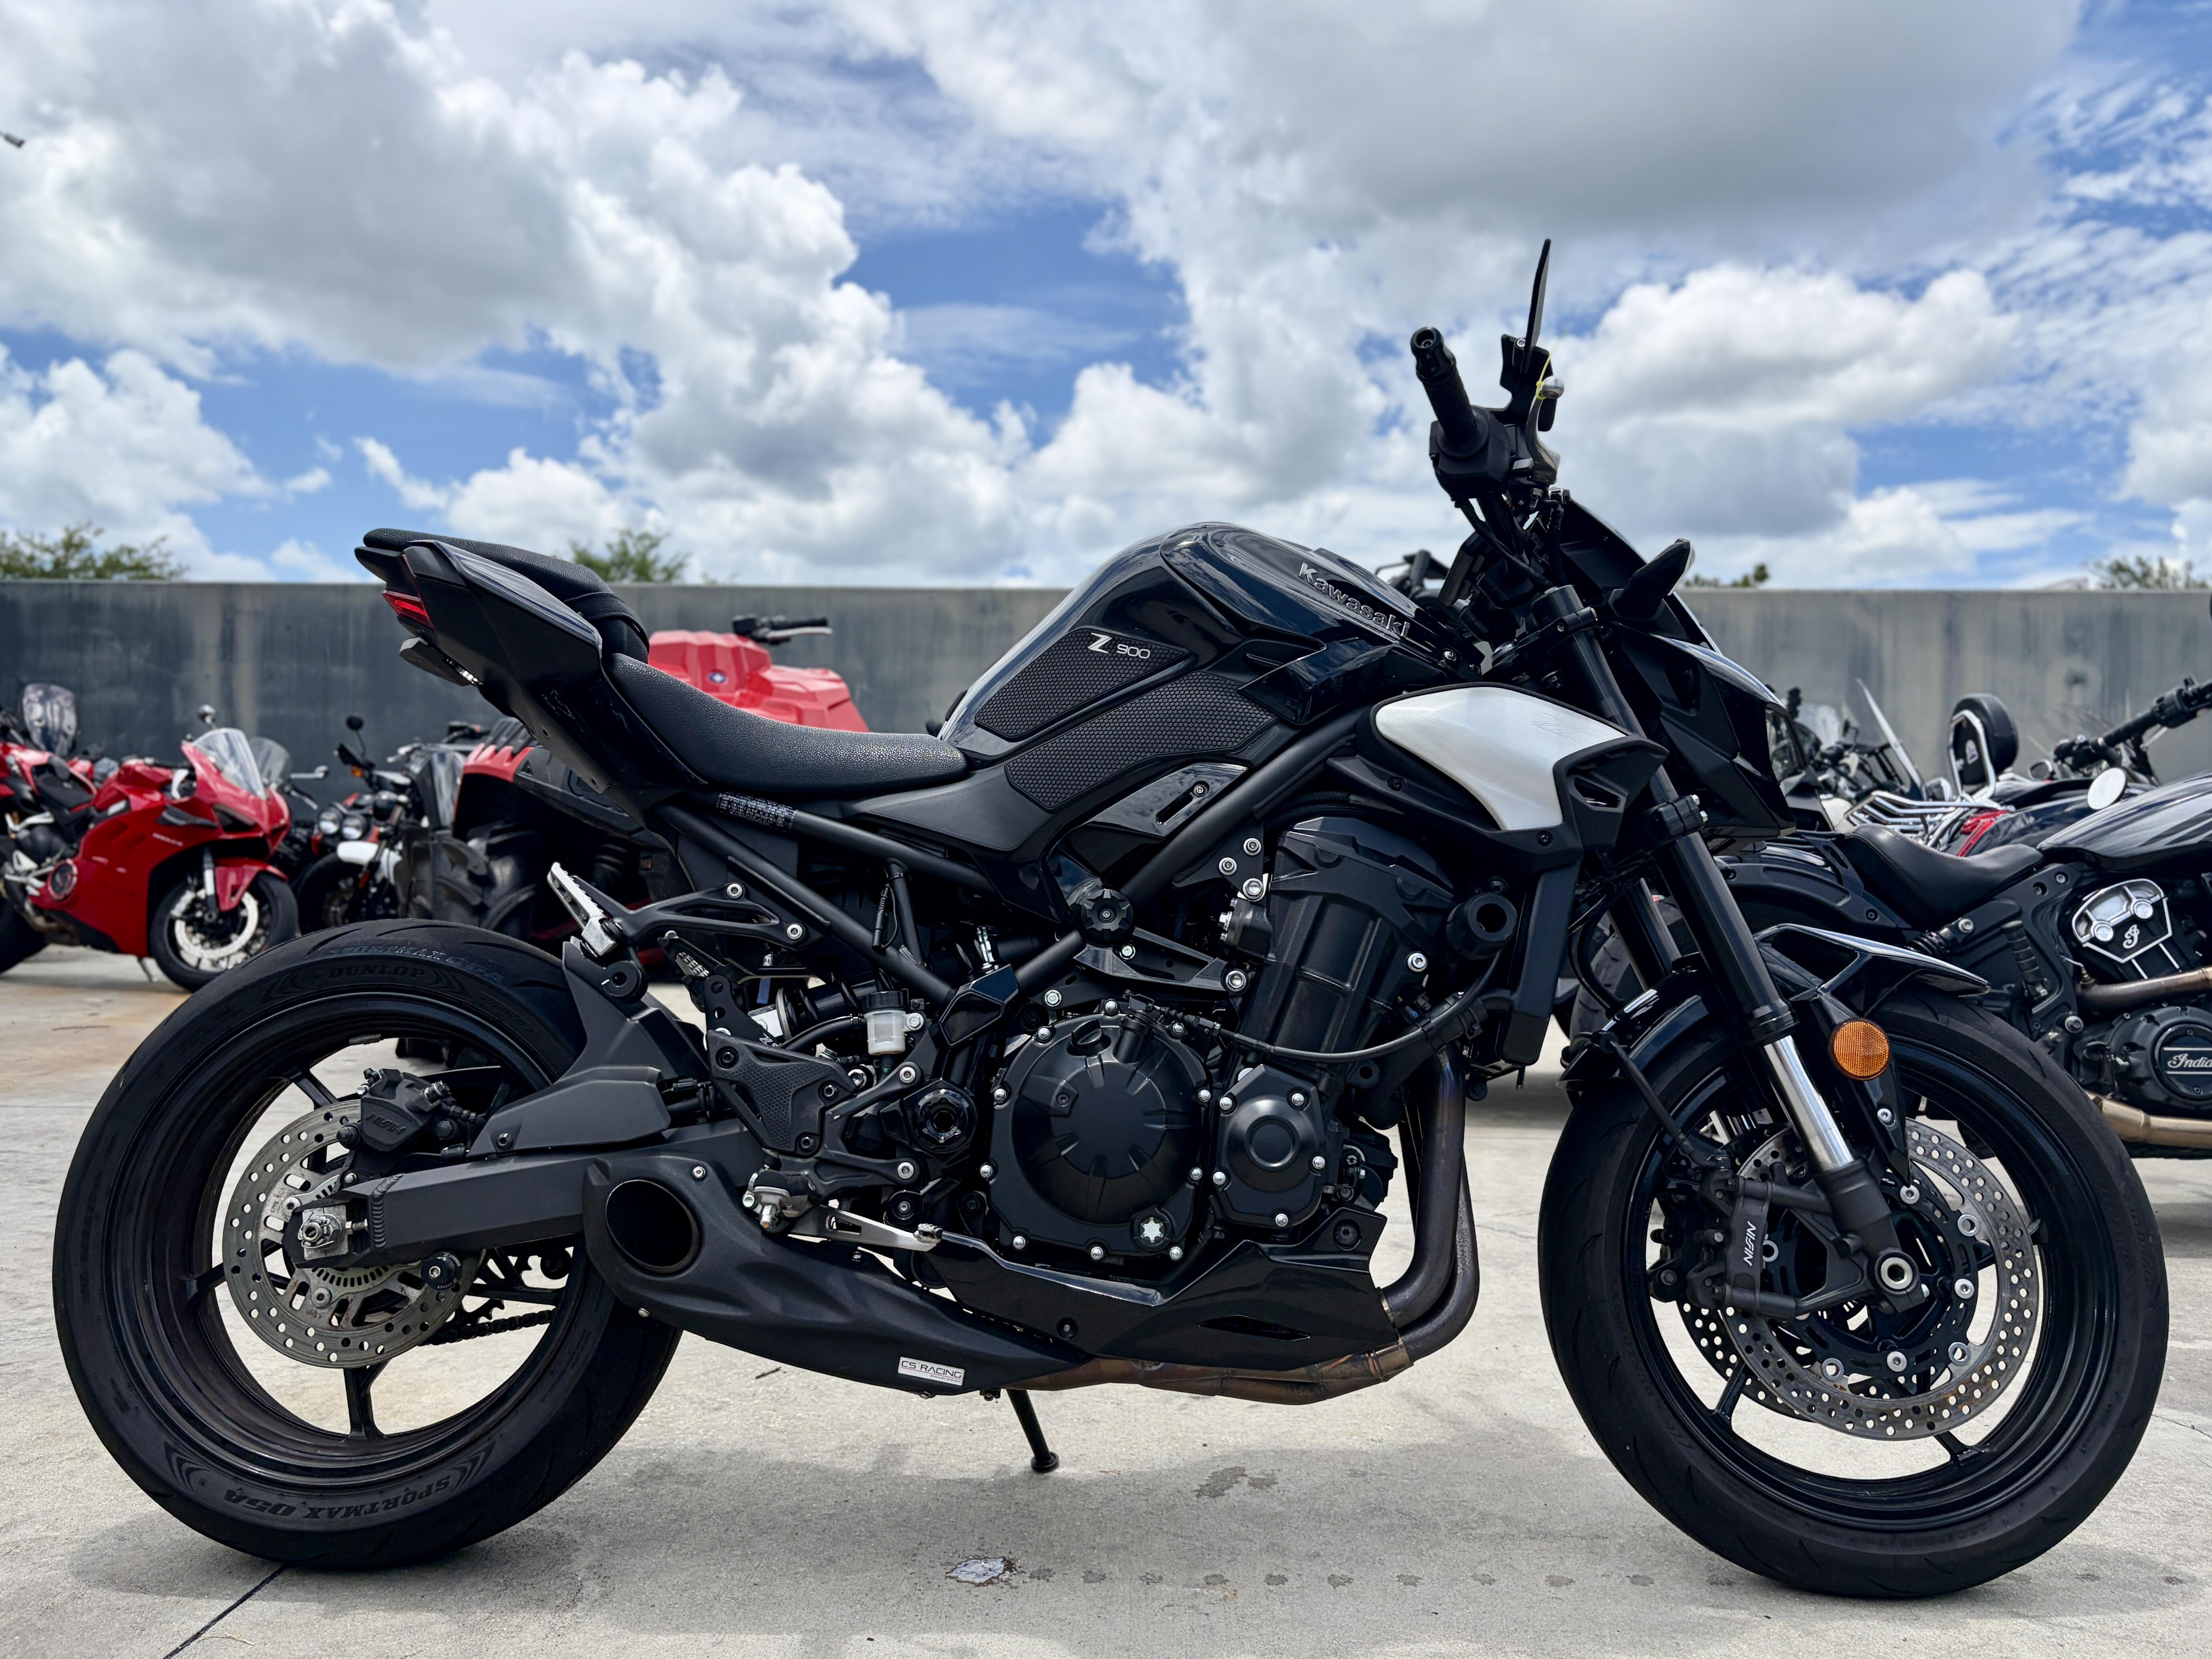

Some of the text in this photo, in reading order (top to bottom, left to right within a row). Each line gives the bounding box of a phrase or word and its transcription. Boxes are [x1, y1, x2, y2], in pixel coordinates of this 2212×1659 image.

[1299, 562, 1411, 637] Kawasaki
[1088, 632, 1151, 659] Z 900
[328, 965, 426, 979] DUNLOP
[901, 1360, 962, 1378] CS RACING
[303, 1475, 451, 1520] SPORTMAX
